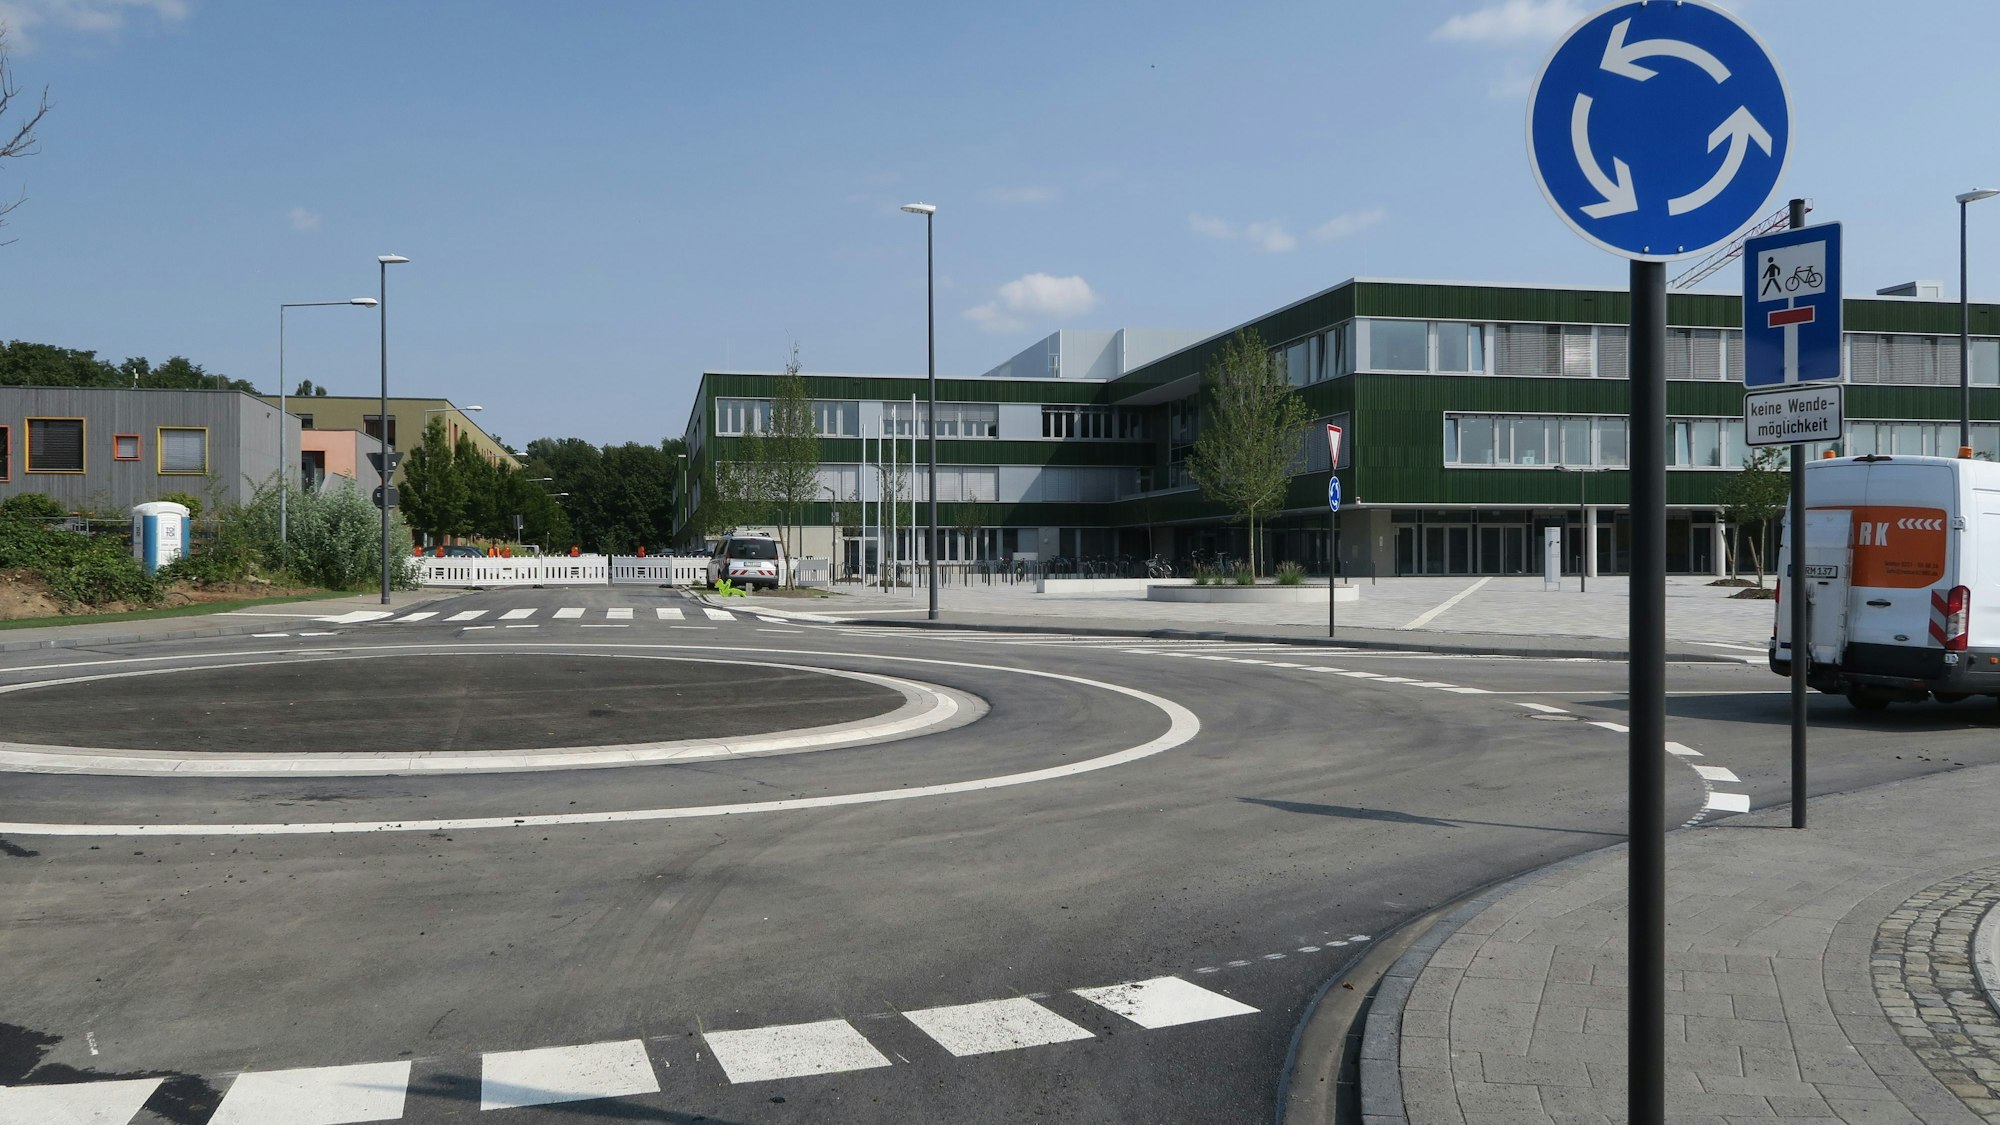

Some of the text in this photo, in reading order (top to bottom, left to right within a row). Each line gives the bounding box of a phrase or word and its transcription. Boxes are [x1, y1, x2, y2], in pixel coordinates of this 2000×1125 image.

[1751, 397, 1835, 416] keine Wende-
[1758, 417, 1828, 438] möglichkeit
